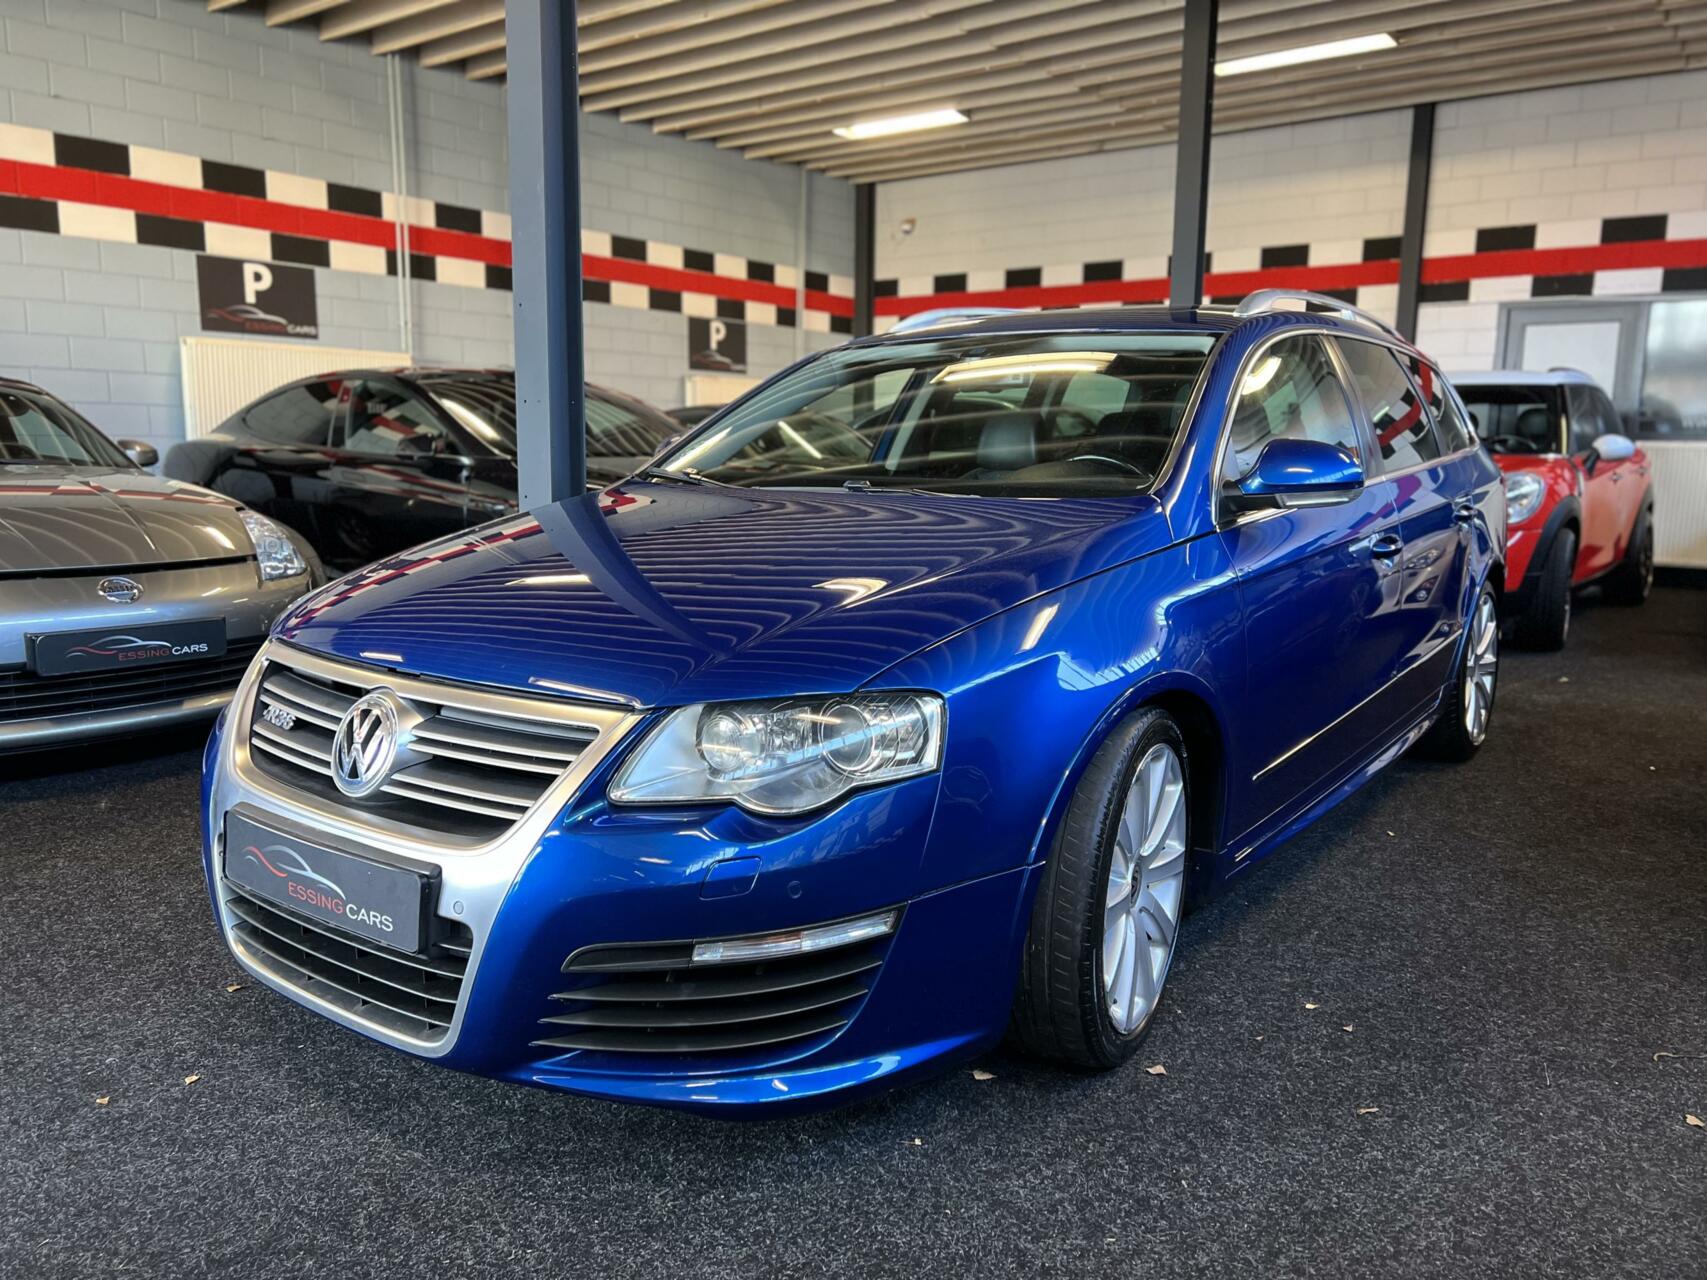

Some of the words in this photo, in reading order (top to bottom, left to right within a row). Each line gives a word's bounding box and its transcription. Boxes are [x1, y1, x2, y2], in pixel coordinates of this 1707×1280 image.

[243, 262, 273, 305] P
[709, 320, 727, 352] P
[171, 643, 208, 655] CARS
[345, 903, 394, 932] CARS
